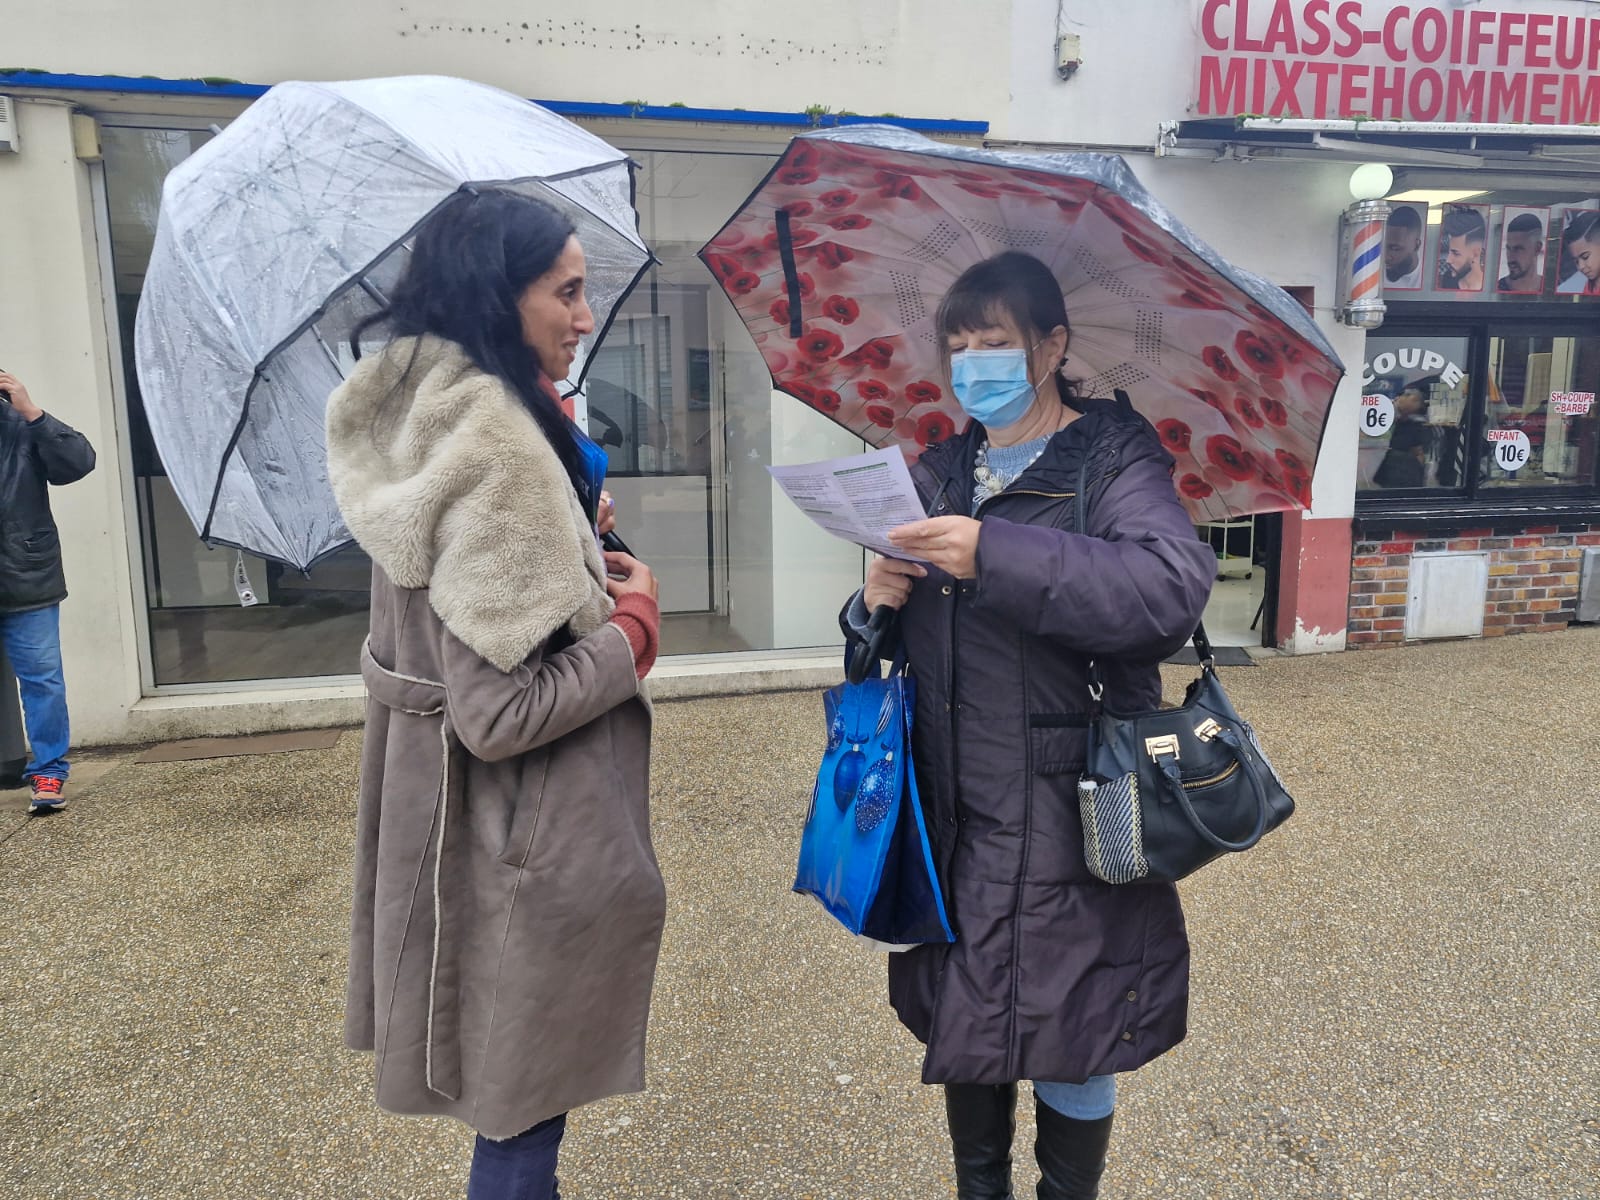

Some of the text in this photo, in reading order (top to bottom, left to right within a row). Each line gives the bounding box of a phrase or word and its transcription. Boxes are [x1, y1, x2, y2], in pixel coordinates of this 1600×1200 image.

[1361, 396, 1380, 406] RBE
[1488, 430, 1520, 441] ENFANT
[1500, 444, 1525, 462] 10€
